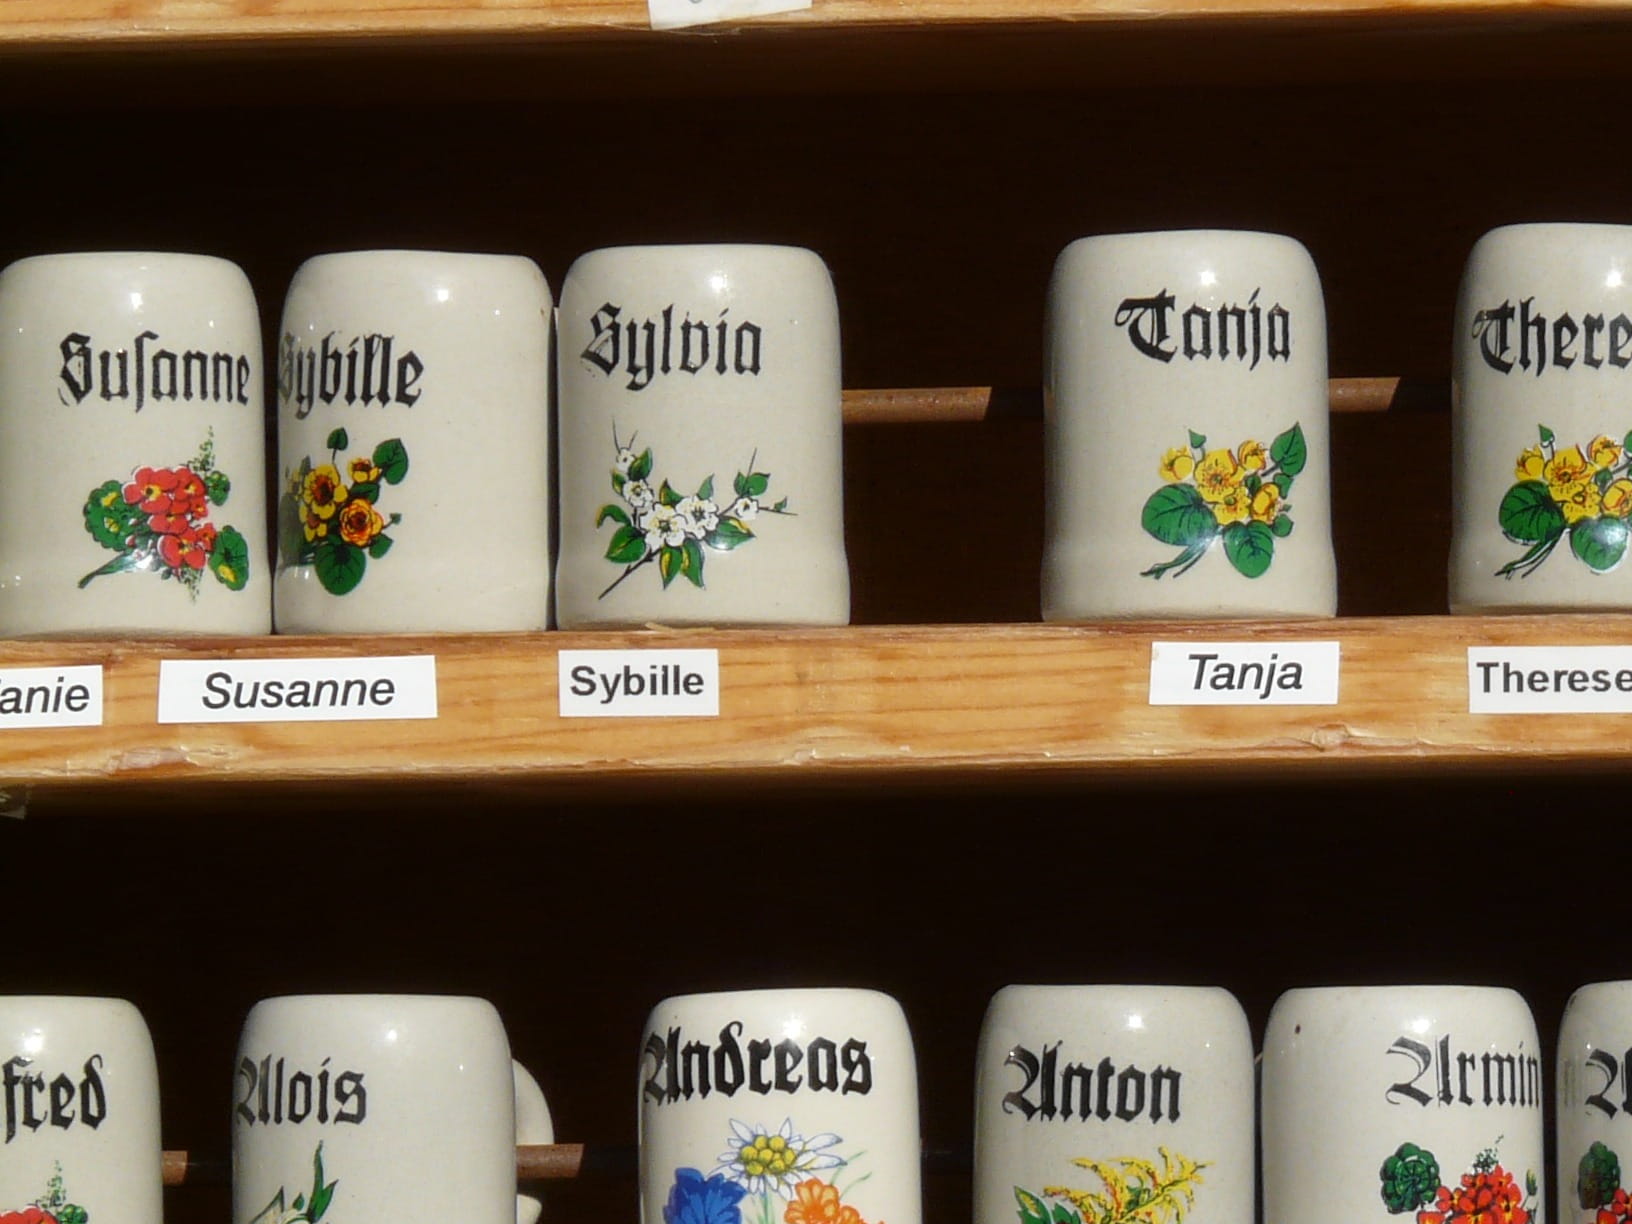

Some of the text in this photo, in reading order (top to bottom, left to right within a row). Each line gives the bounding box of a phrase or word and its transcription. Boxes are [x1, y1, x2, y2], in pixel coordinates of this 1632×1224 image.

[579, 302, 761, 391] Sylvia
[1115, 288, 1290, 370] Tanja
[279, 332, 423, 418] Sybille
[0, 677, 89, 714] anie
[203, 672, 394, 709] Susanne
[571, 665, 704, 704] Sybille
[1189, 654, 1302, 692] Tanja
[233, 1055, 366, 1126] Alois
[643, 1020, 872, 1103] Andreas
[1002, 1041, 1181, 1124] Anton
[1387, 1033, 1539, 1109] Armin
